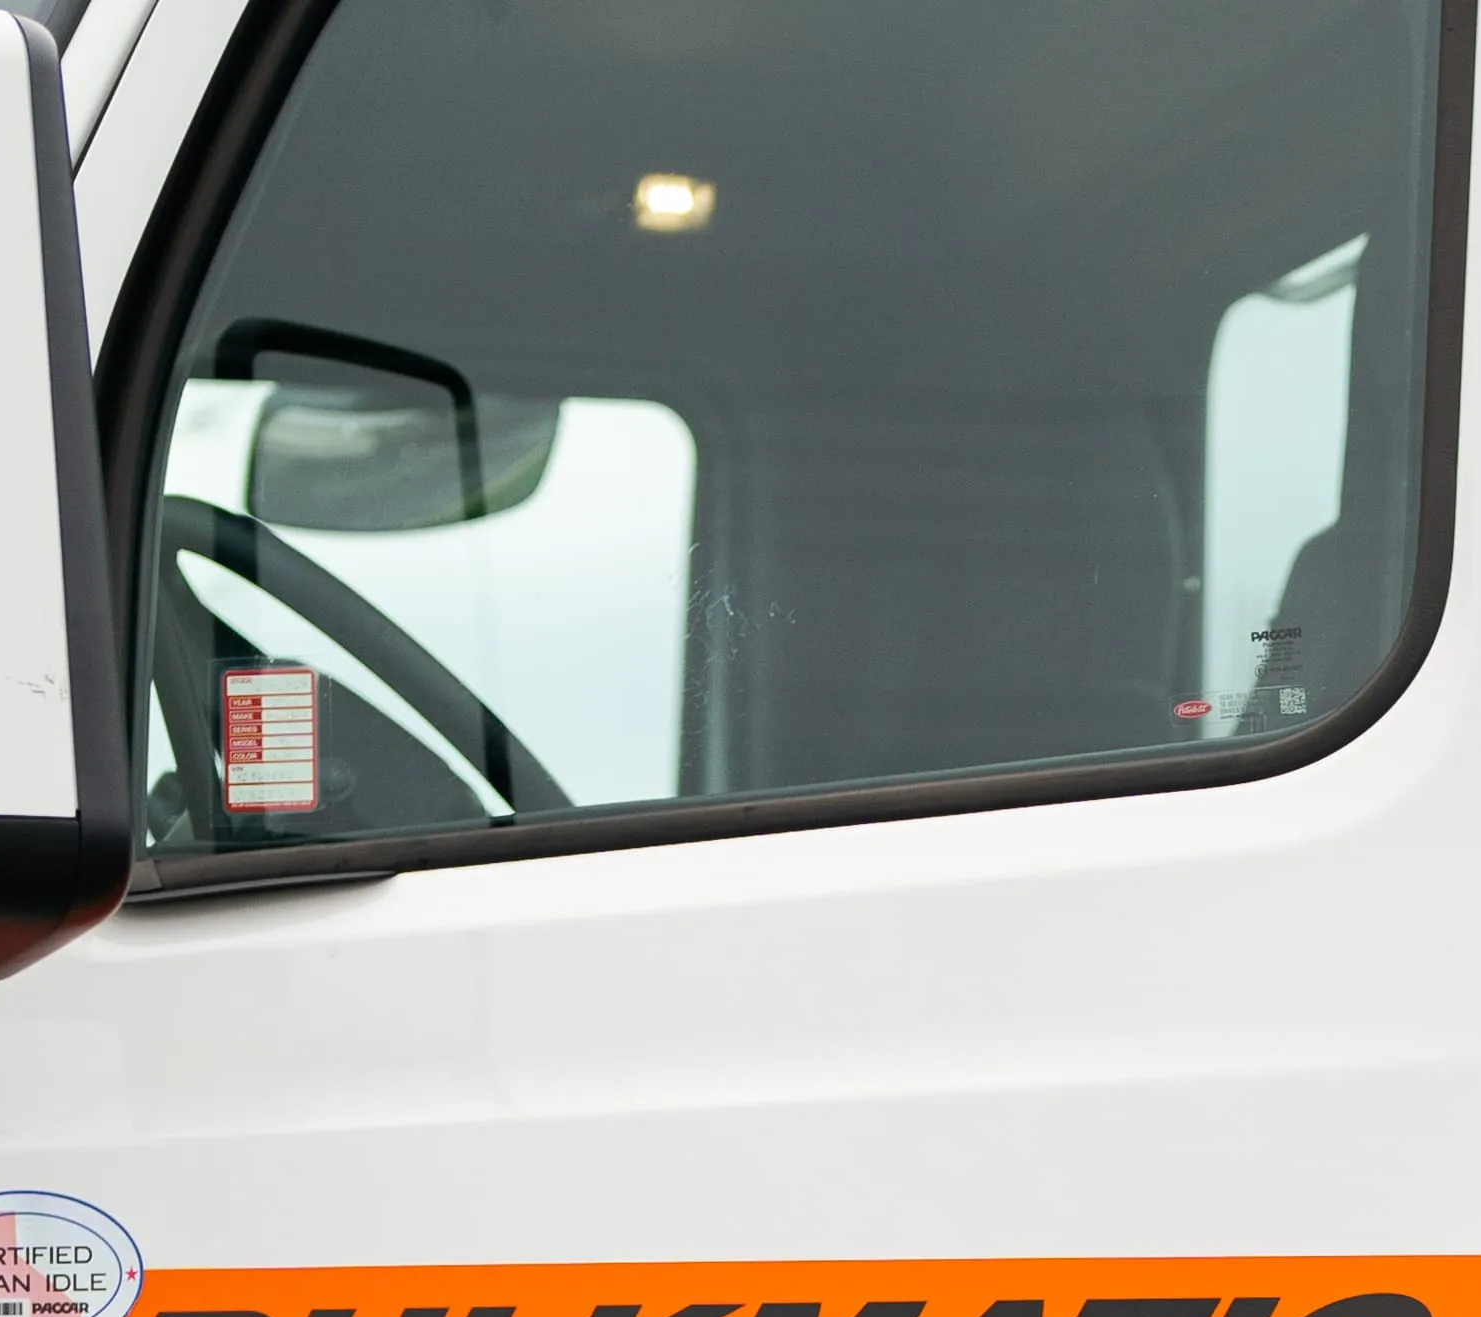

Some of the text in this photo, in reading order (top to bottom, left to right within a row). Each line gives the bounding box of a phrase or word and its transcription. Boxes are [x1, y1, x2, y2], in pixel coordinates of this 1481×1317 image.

[1251, 627, 1303, 642] PACCAR
[232, 739, 258, 747] MODEL
[232, 752, 258, 761] COLOR
[46, 1273, 107, 1292] IDLE
[31, 1301, 89, 1315] PACCAR
